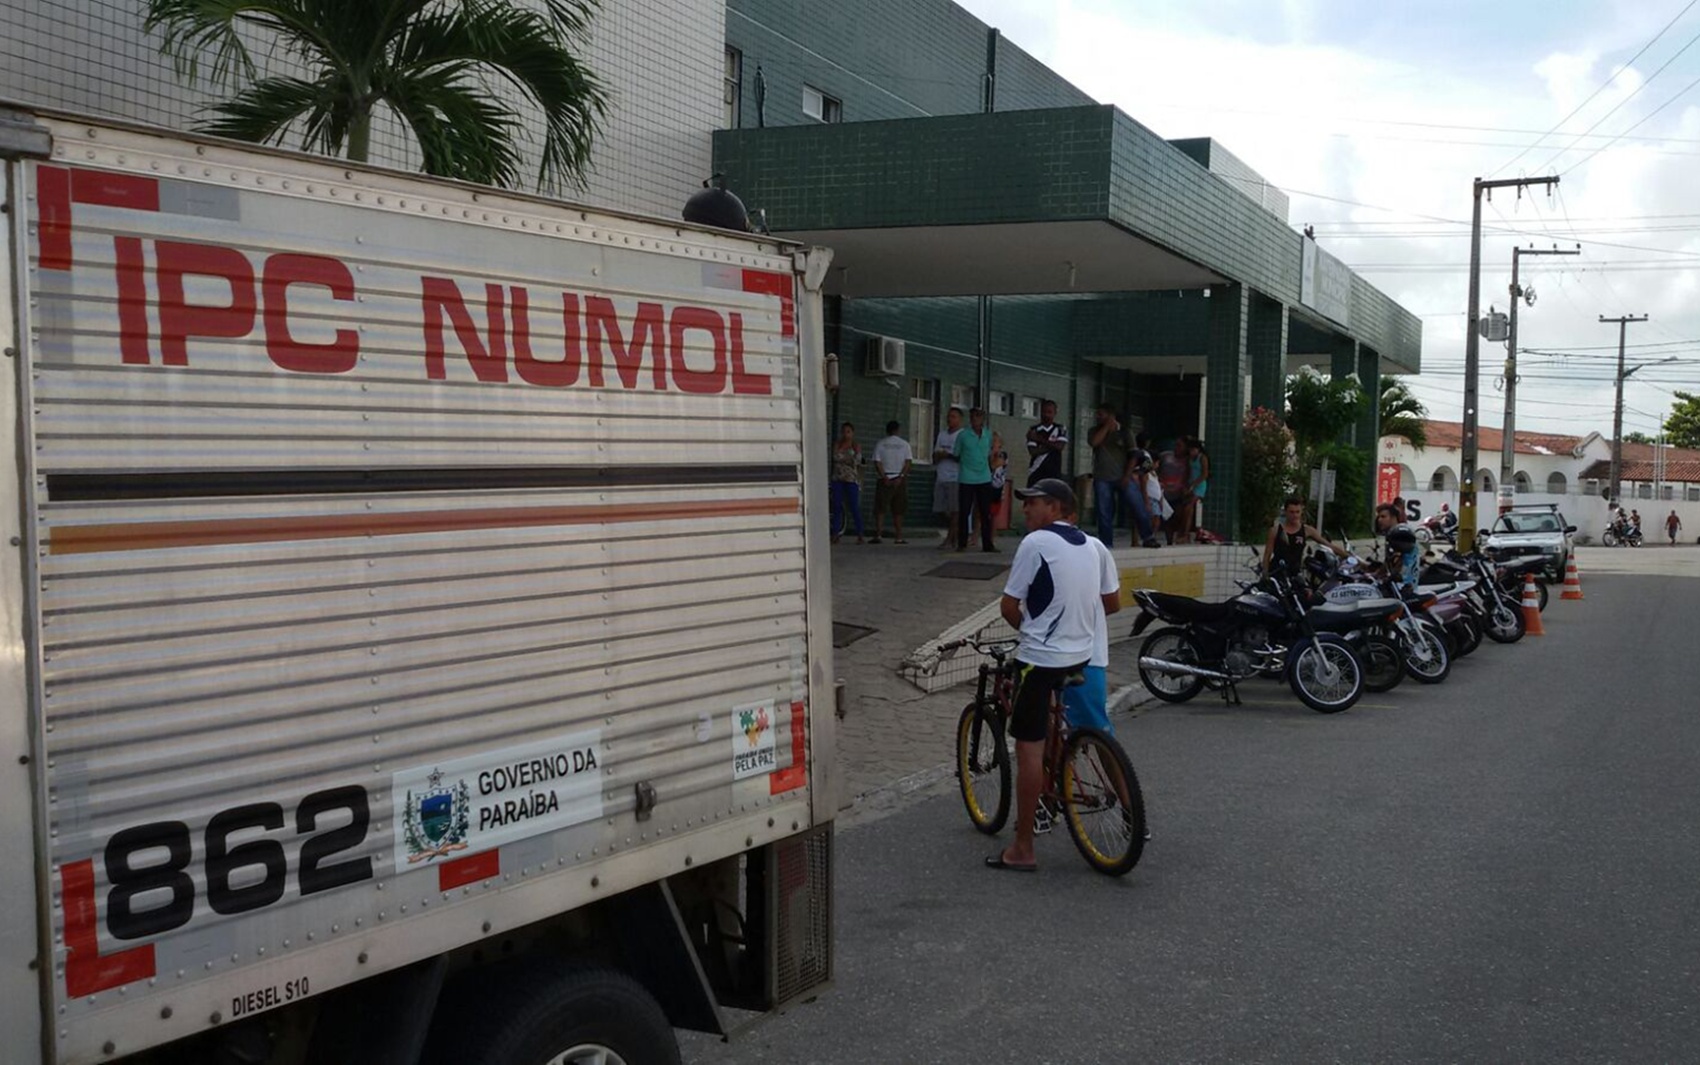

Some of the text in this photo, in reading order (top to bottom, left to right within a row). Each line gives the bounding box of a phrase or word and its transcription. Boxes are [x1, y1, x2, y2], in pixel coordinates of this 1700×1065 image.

[115, 235, 773, 396] IPC NUMOL
[1405, 499, 1421, 522] S
[478, 747, 598, 796] GOVERNO DA
[735, 752, 774, 773] PELA PAZ
[478, 788, 560, 832] PARAÍBA
[104, 784, 374, 941] 862
[232, 976, 309, 1017] DIESEL S10
